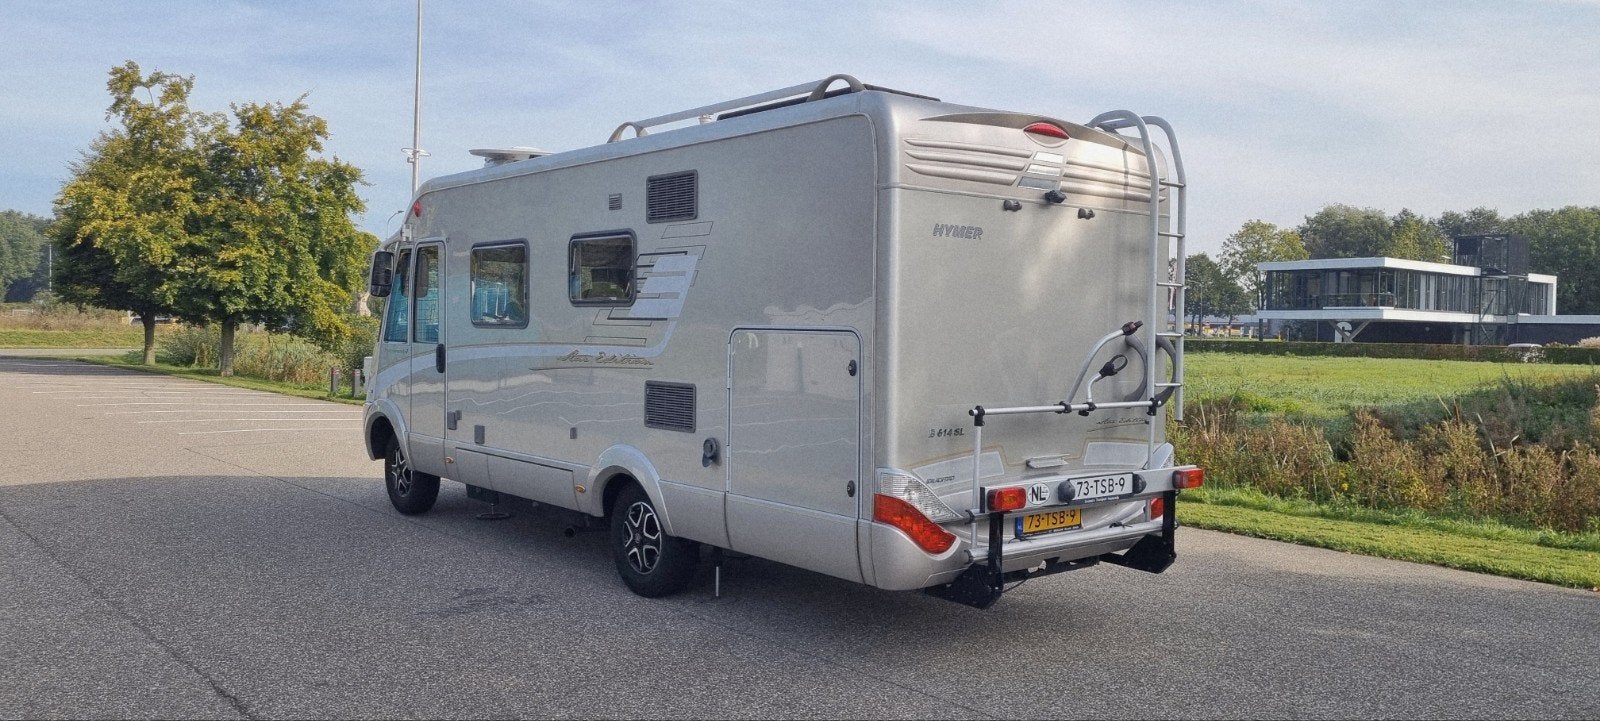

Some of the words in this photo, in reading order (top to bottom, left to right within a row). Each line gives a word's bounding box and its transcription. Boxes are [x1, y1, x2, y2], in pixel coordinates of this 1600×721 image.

[932, 223, 984, 240] HYMER
[937, 428, 953, 438] 614
[953, 427, 965, 437] SL
[1031, 485, 1047, 502] NL
[1076, 477, 1126, 497] 73-TSB-9
[1028, 509, 1077, 529] 73-TSB-9
